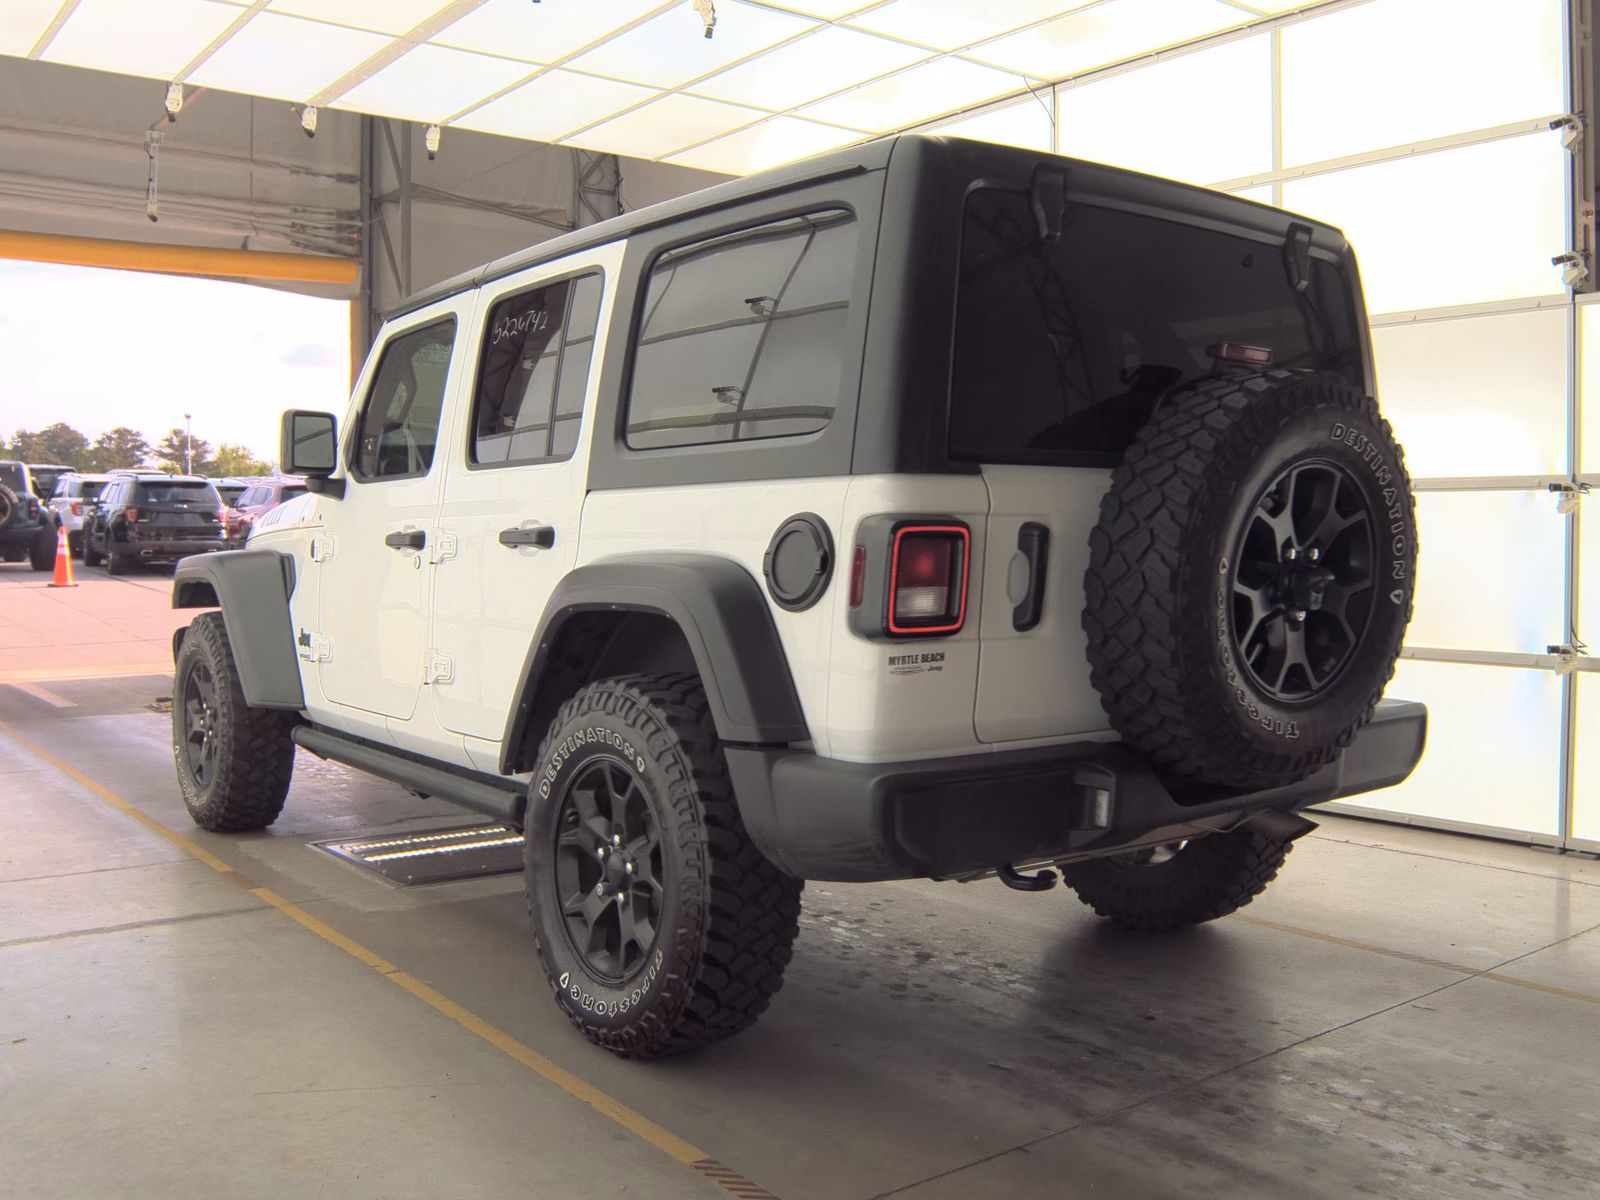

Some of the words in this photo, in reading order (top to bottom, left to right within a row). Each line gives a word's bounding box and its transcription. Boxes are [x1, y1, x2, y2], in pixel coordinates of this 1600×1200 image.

[1331, 423, 1406, 579] DESTINATION
[888, 654, 919, 666] MYRTLE
[921, 652, 945, 663] BEACH
[539, 727, 635, 799] DESTINATION
[570, 948, 663, 1018] Firestone
